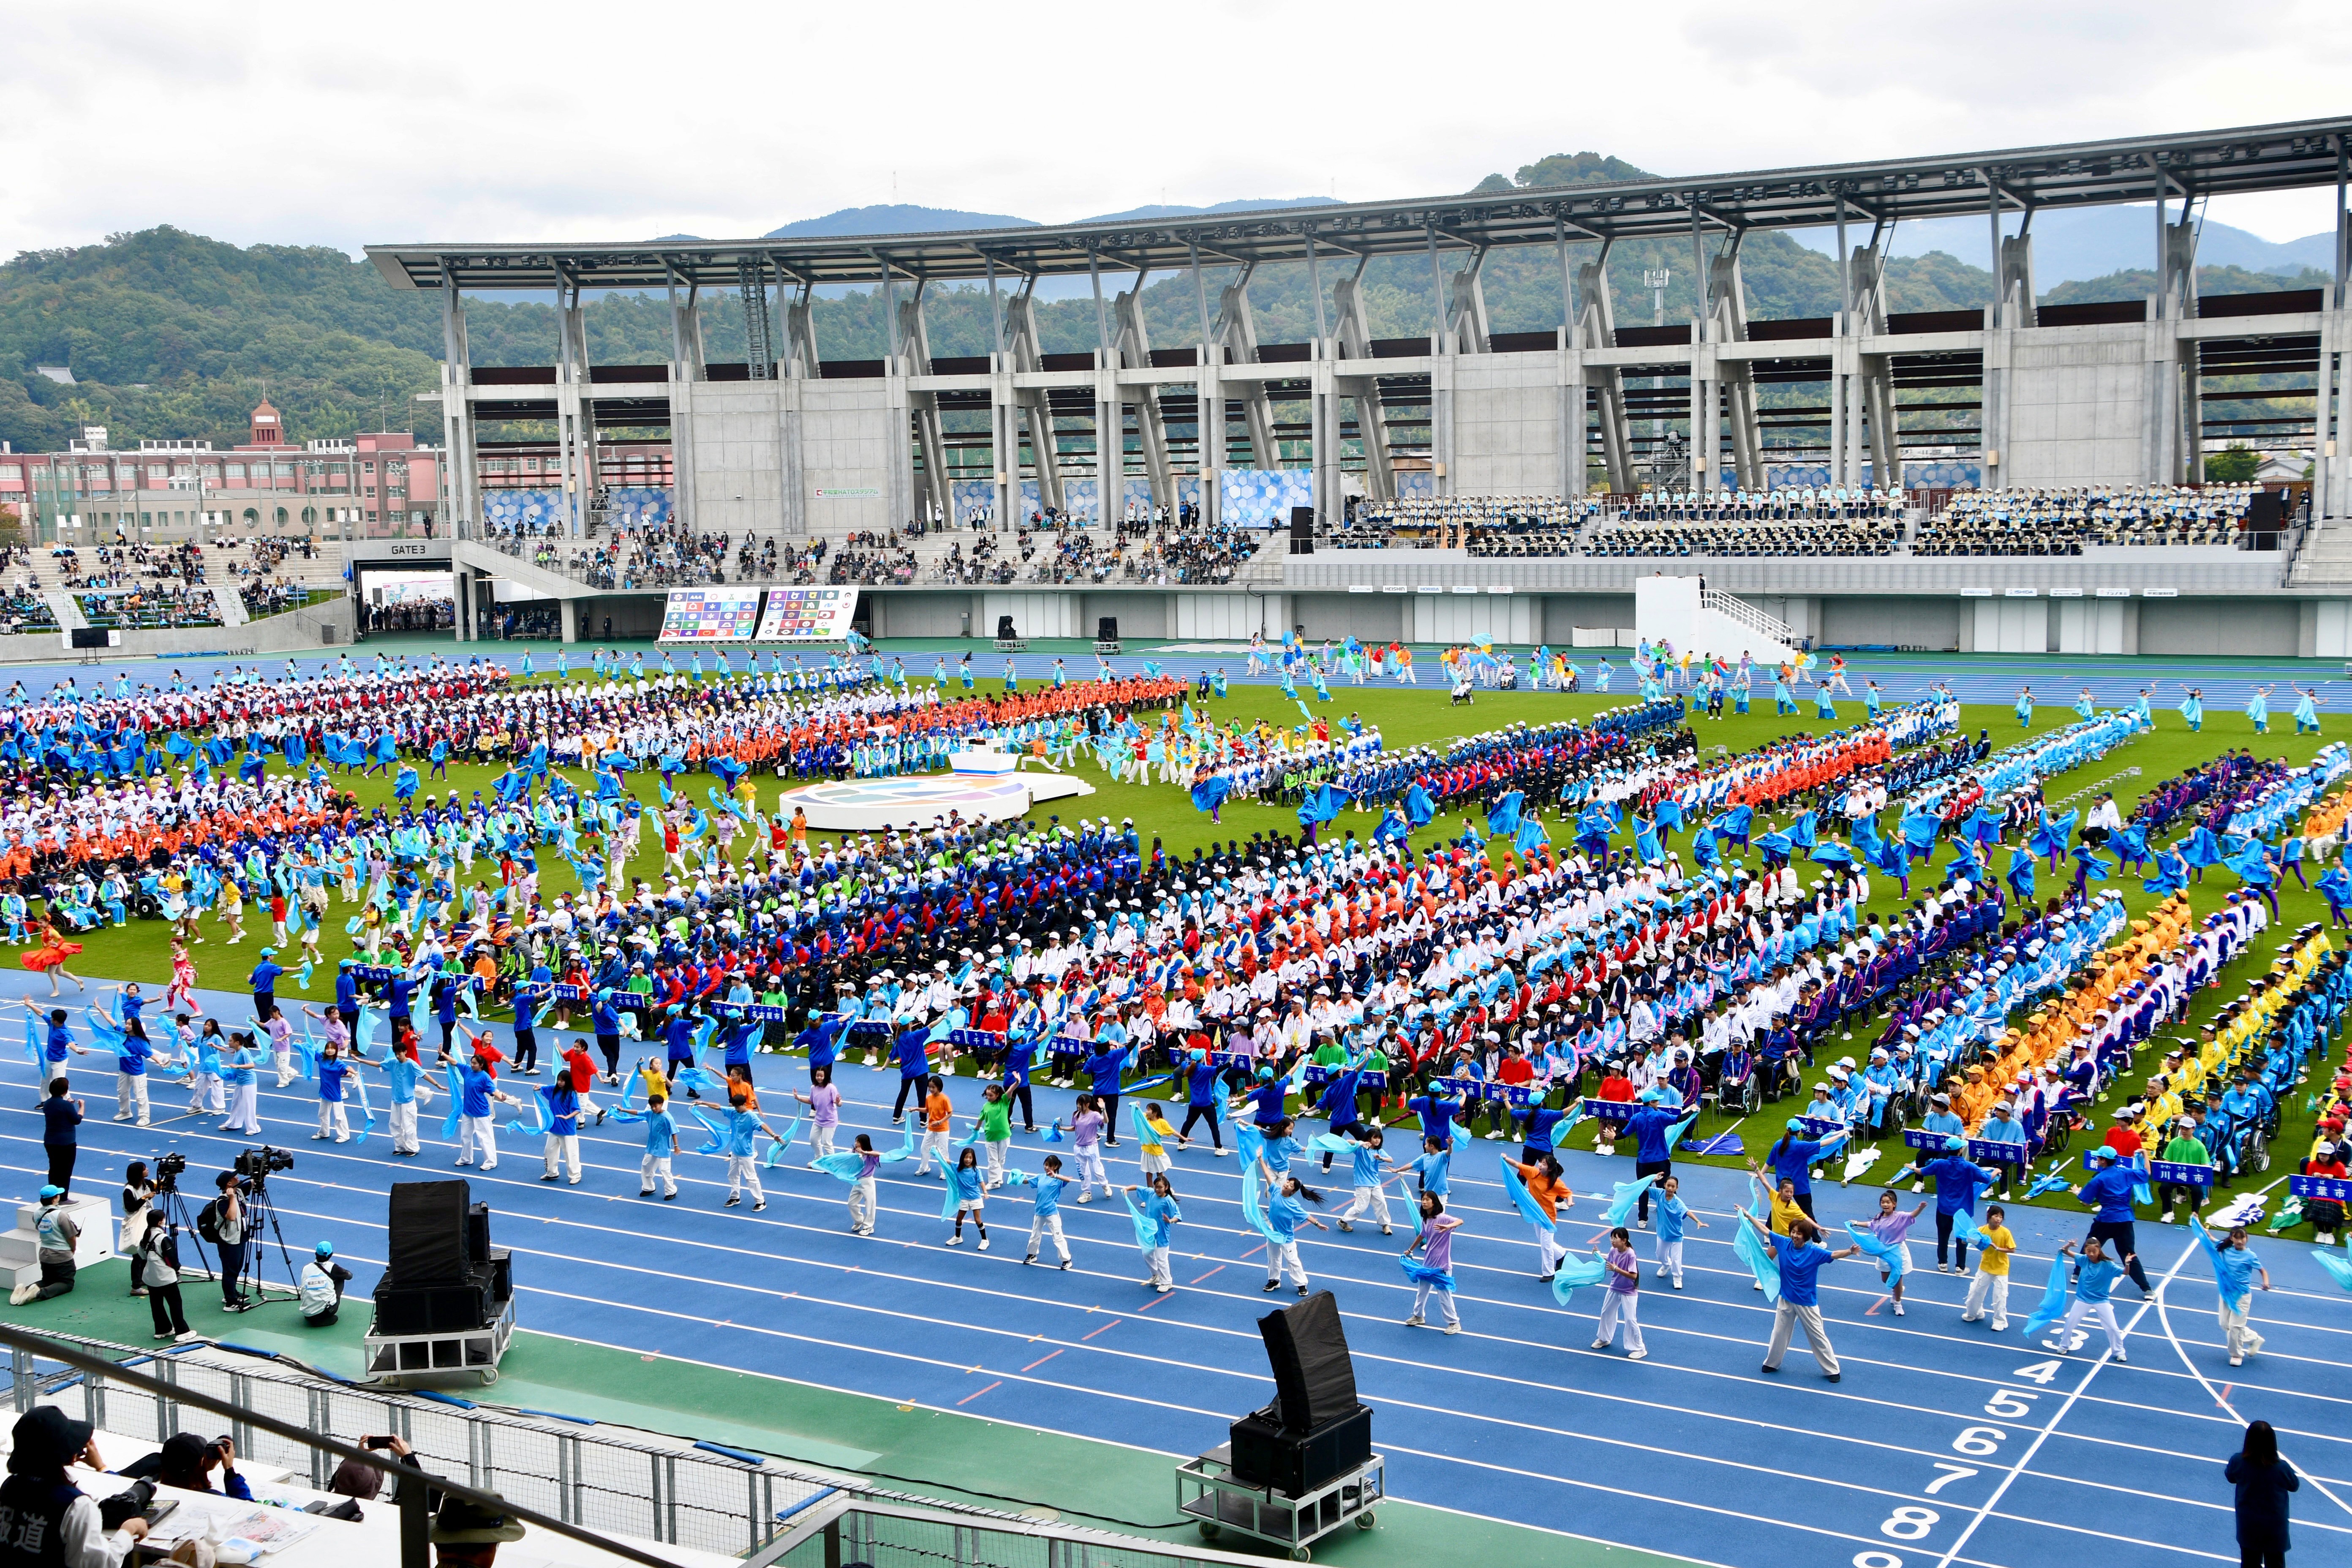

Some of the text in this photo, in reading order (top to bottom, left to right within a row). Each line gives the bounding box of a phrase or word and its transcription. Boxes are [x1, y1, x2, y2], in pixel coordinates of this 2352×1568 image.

[392, 545, 425, 554] GATE 3
[618, 998, 639, 1006] 大阪府
[751, 1011, 780, 1020] 名古屋市
[1051, 1042, 1075, 1053] 群馬県
[1307, 1072, 1325, 1081] 佐賀
[1444, 1085, 1475, 1096] 山口県
[1592, 1108, 1626, 1118] 奈良県
[1976, 1142, 2014, 1150] いしかわけん
[1976, 1148, 2015, 1160] 石川県
[2160, 1164, 2201, 1173] かわさきし
[2160, 1171, 2204, 1183] 川崎市
[2303, 1178, 2342, 1187] ちばし
[2299, 1184, 2346, 1198] 千葉市
[2013, 1360, 2063, 1384] 4
[1984, 1389, 2039, 1418] 5
[1952, 1427, 2006, 1456] 6
[1924, 1462, 1979, 1494] 7
[1881, 1506, 1940, 1540] 8
